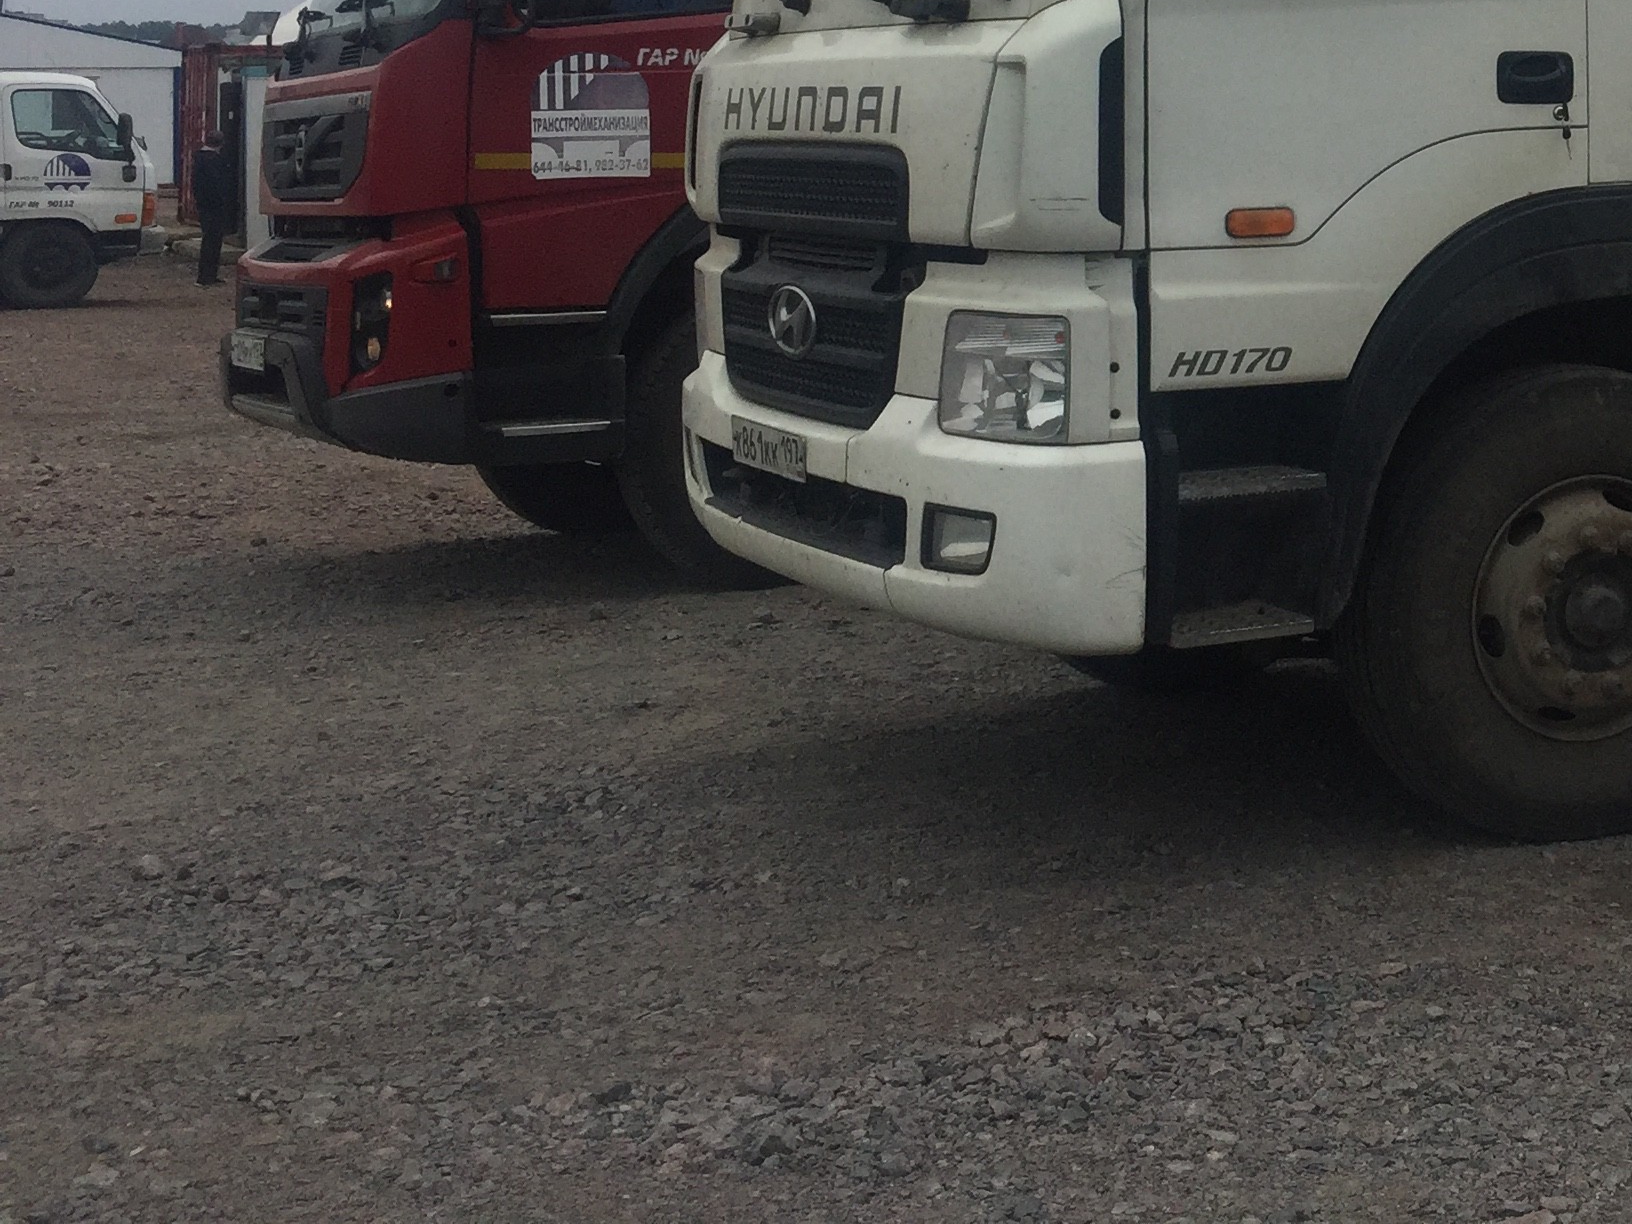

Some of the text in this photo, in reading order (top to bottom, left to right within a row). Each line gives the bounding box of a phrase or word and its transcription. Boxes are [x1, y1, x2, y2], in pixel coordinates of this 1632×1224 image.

[637, 48, 679, 66] ГАР
[724, 85, 902, 134] HYUNDAI
[533, 113, 648, 133] ТРАНССТРОЙМЕХАНИЗАЦИЯ
